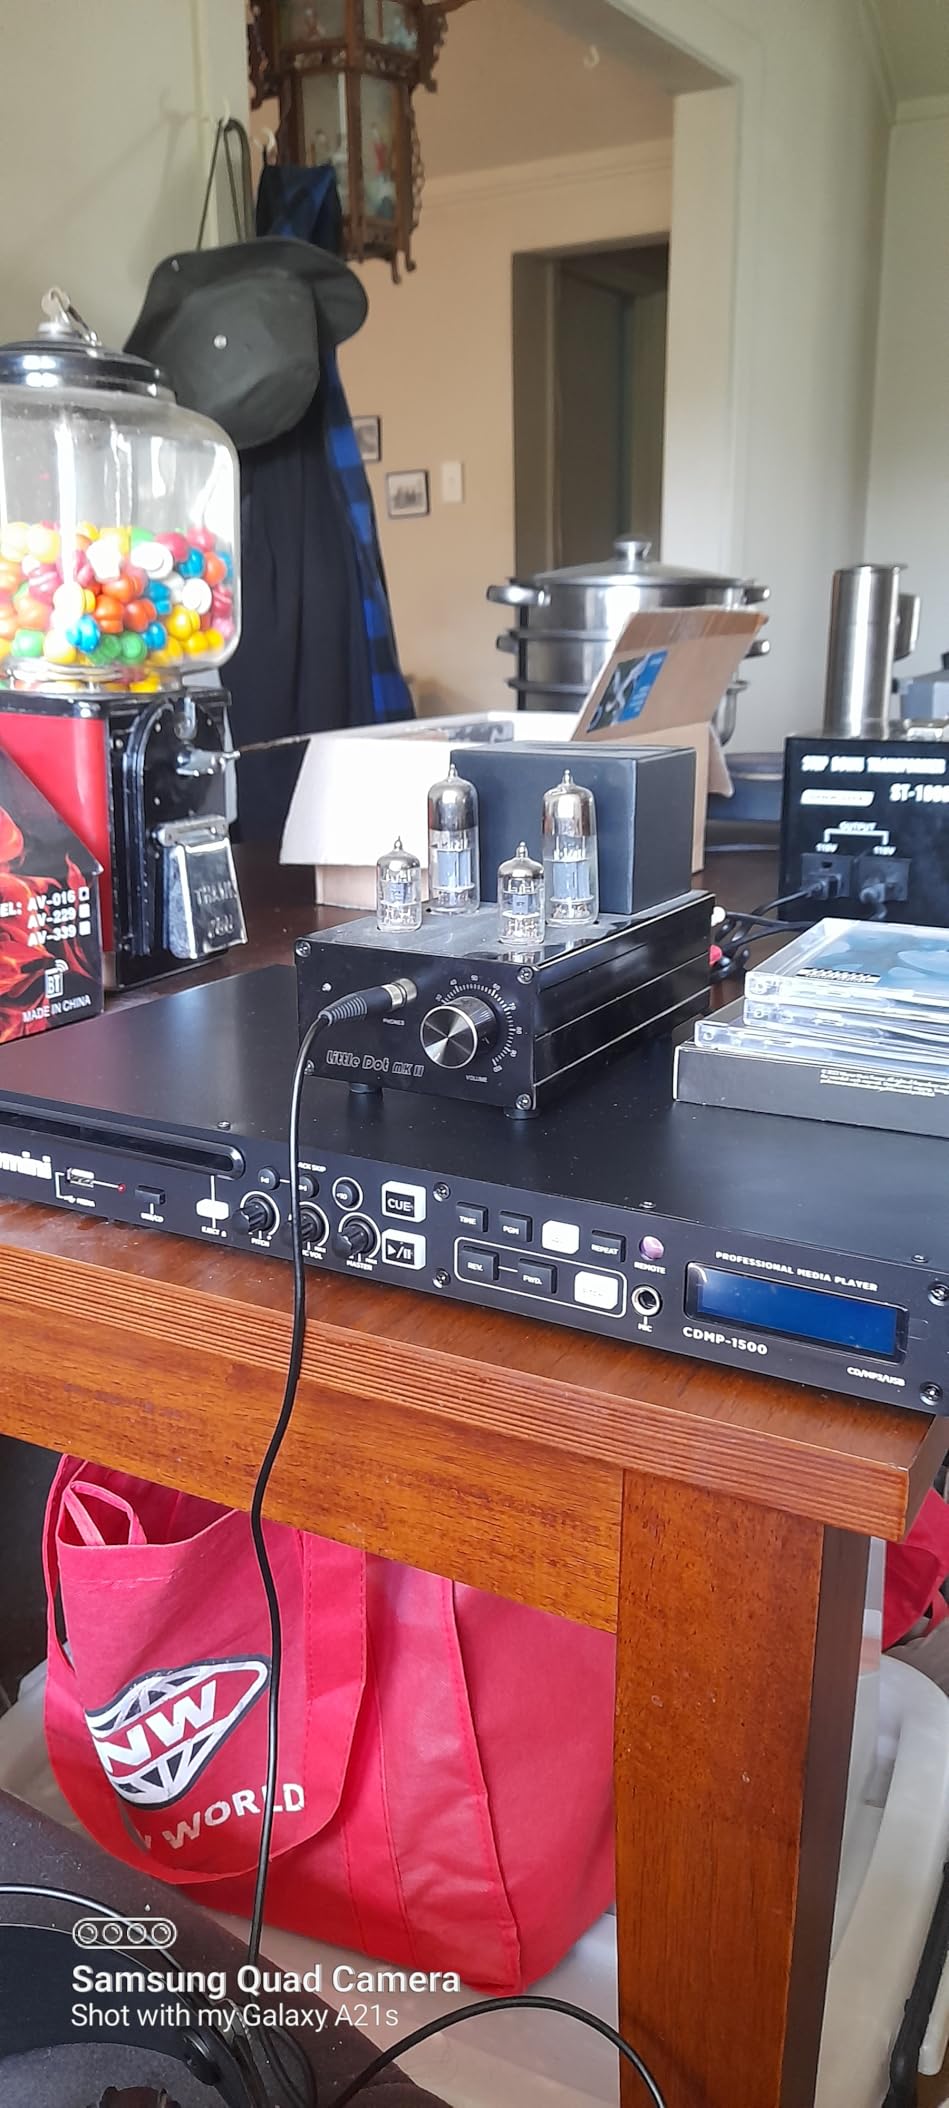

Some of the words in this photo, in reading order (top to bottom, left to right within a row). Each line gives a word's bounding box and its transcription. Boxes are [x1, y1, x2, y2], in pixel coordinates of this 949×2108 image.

[0, 901, 22, 918] EL:
[27, 890, 76, 912] AV-016
[27, 906, 76, 929] AV-229
[27, 924, 77, 947] AV-339
[22, 1004, 51, 1022] MADE
[51, 1002, 62, 1015] IN
[62, 994, 91, 1012] CHINA
[362, 1055, 389, 1072] Dot
[0, 1150, 52, 1180] mini
[297, 1161, 311, 1171] ACK
[387, 1198, 411, 1212] CUE
[459, 1215, 476, 1226] TIME
[591, 1243, 619, 1255] REPEAT
[346, 1260, 373, 1271] MASTER
[634, 1261, 666, 1275] REMOTE
[715, 1250, 794, 1275] PROFESSIONAL
[797, 1267, 831, 1283] MEDIA
[834, 1275, 878, 1292] PLAYER
[682, 1326, 768, 1355] CDMP-1500
[92, 1680, 216, 1774] NW
